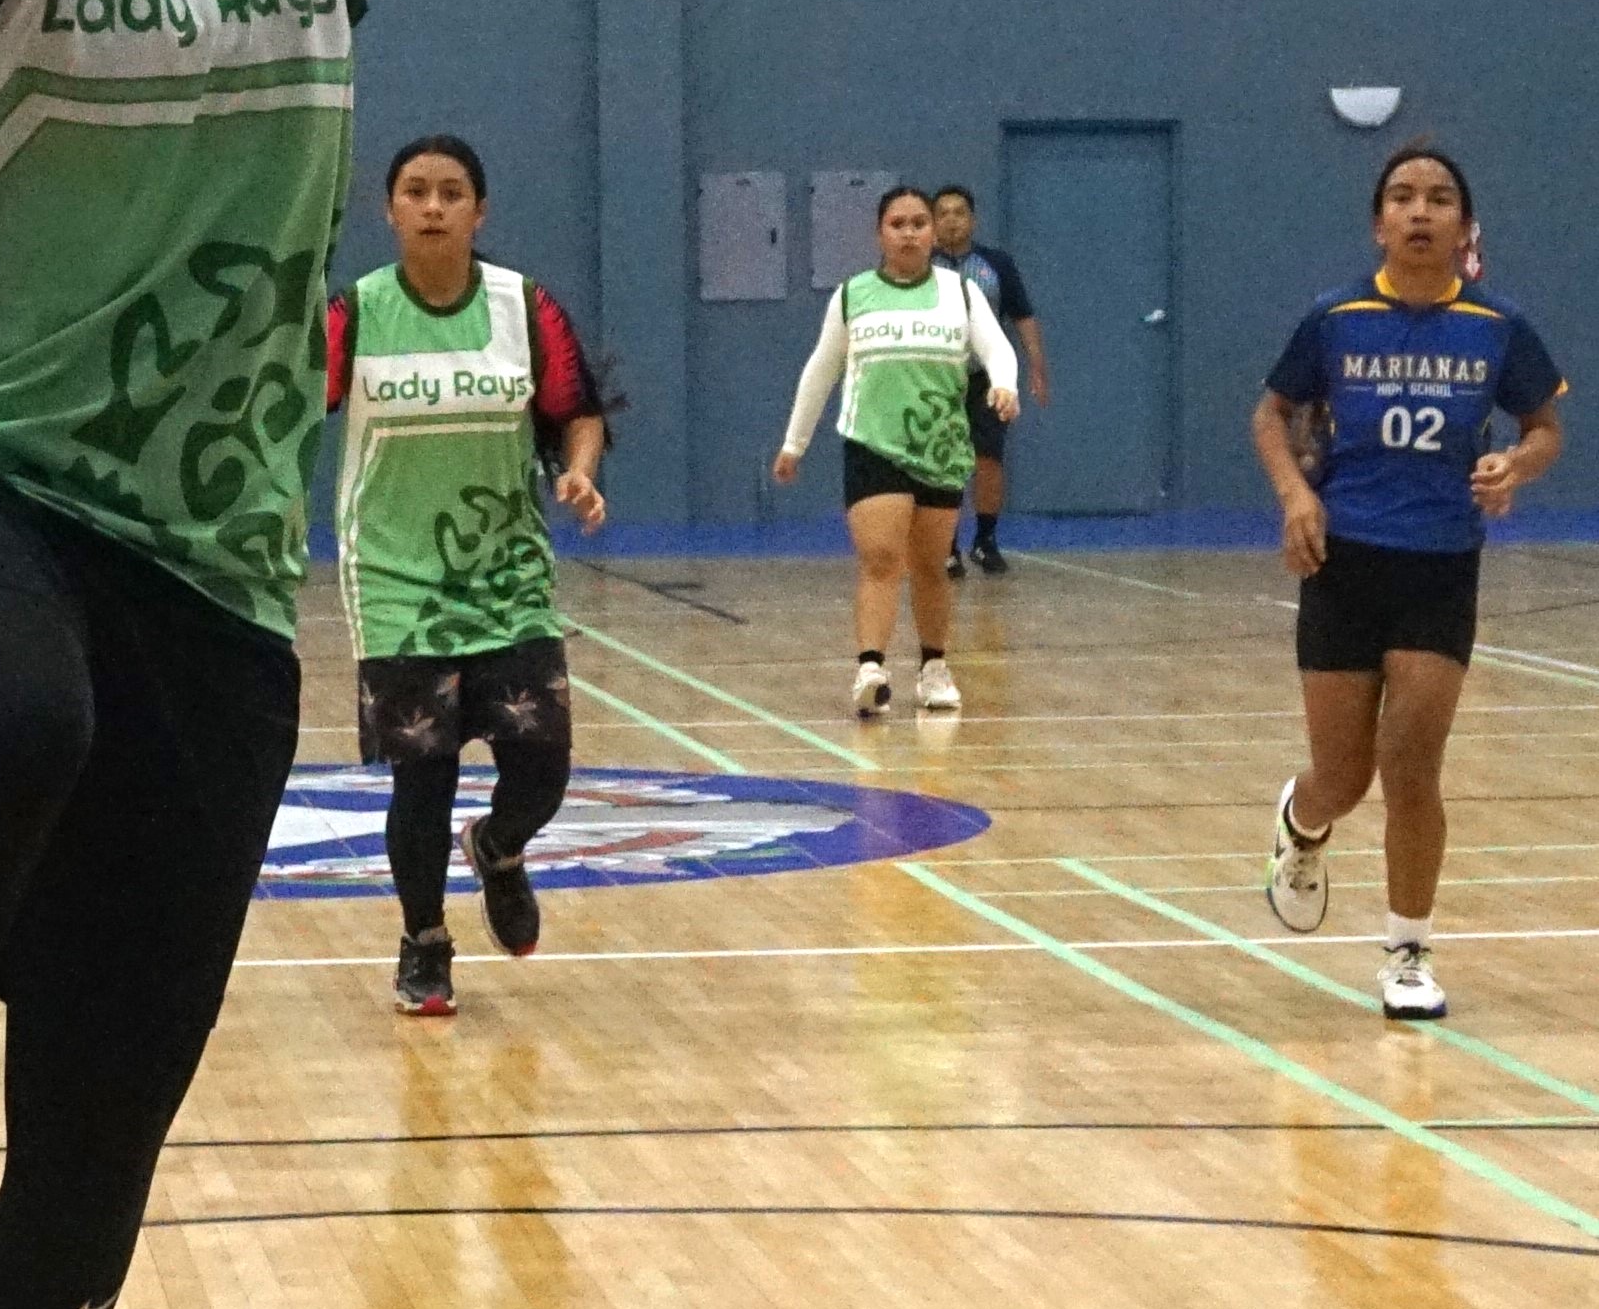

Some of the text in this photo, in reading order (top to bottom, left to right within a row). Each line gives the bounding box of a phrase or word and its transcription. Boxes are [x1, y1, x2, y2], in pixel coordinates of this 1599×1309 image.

[912, 320, 962, 343] Rays
[1343, 354, 1488, 383] MARIANAS
[362, 370, 527, 406] Lady Rays
[1410, 382, 1454, 397] SCHOOL
[1382, 406, 1445, 451] 02
